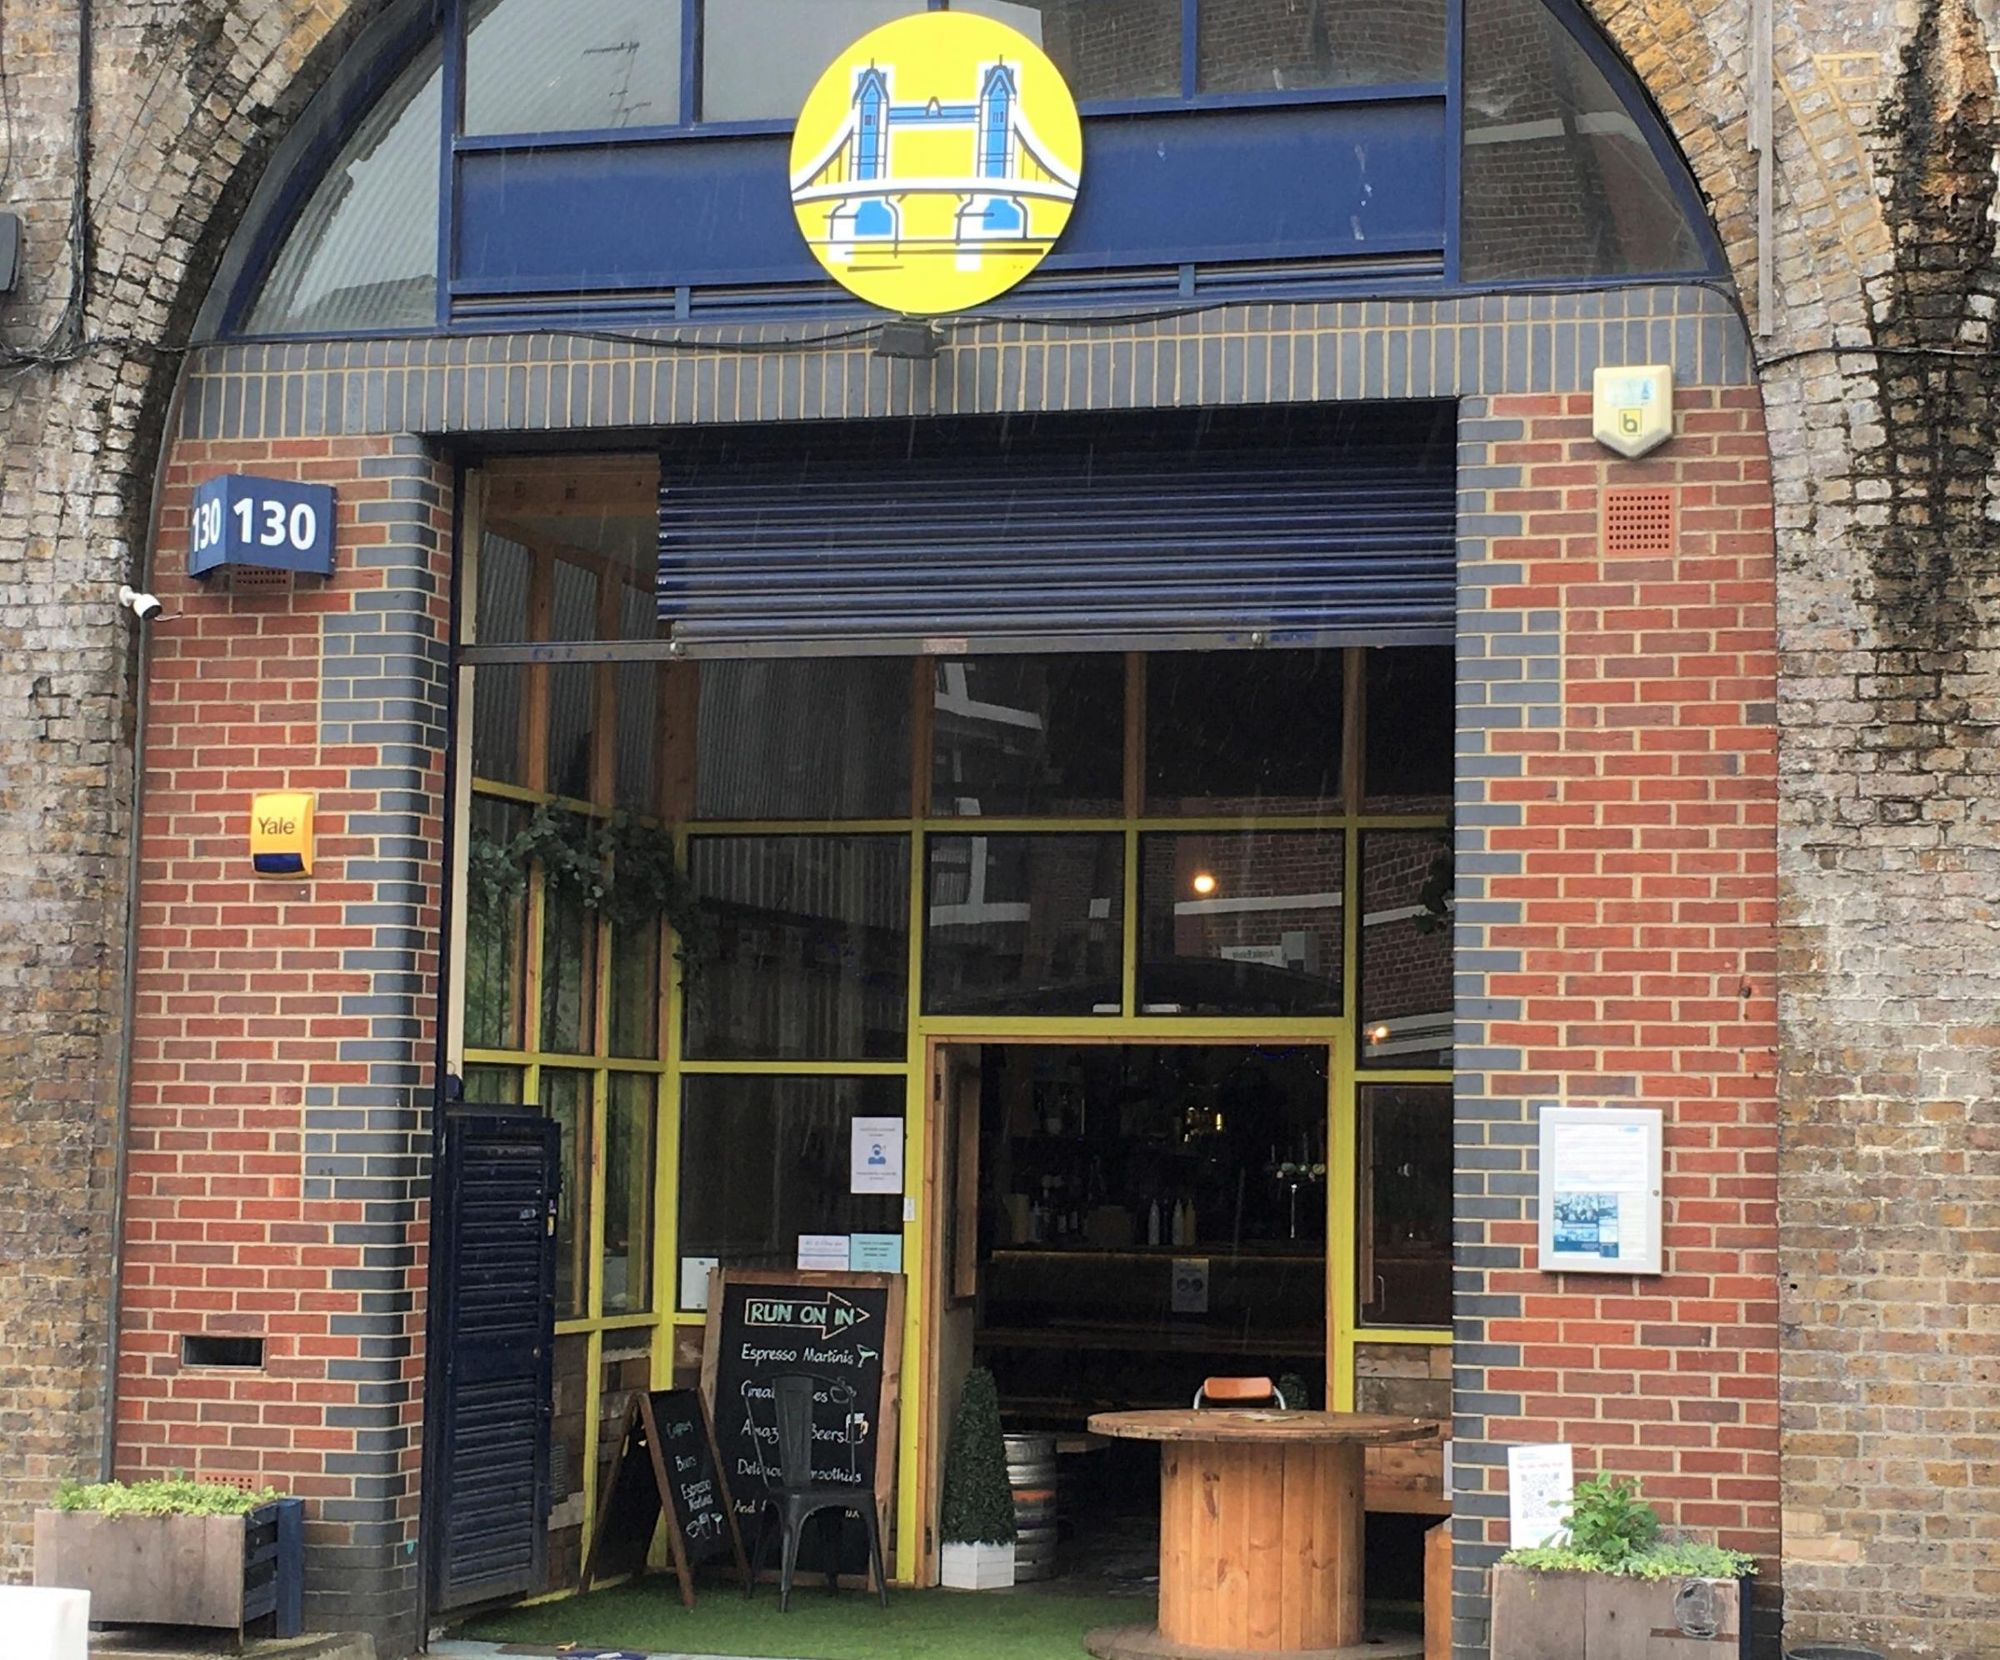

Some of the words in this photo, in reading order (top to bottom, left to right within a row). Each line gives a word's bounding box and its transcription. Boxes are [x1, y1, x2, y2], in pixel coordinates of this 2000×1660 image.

[192, 498, 221, 552] 130
[233, 498, 316, 550] 130
[258, 816, 295, 835] Yale
[751, 1303, 792, 1322] RUN
[800, 1306, 827, 1324] ON
[834, 1308, 855, 1325] IN
[741, 1343, 797, 1367] Espresso
[803, 1347, 854, 1365] Martinis
